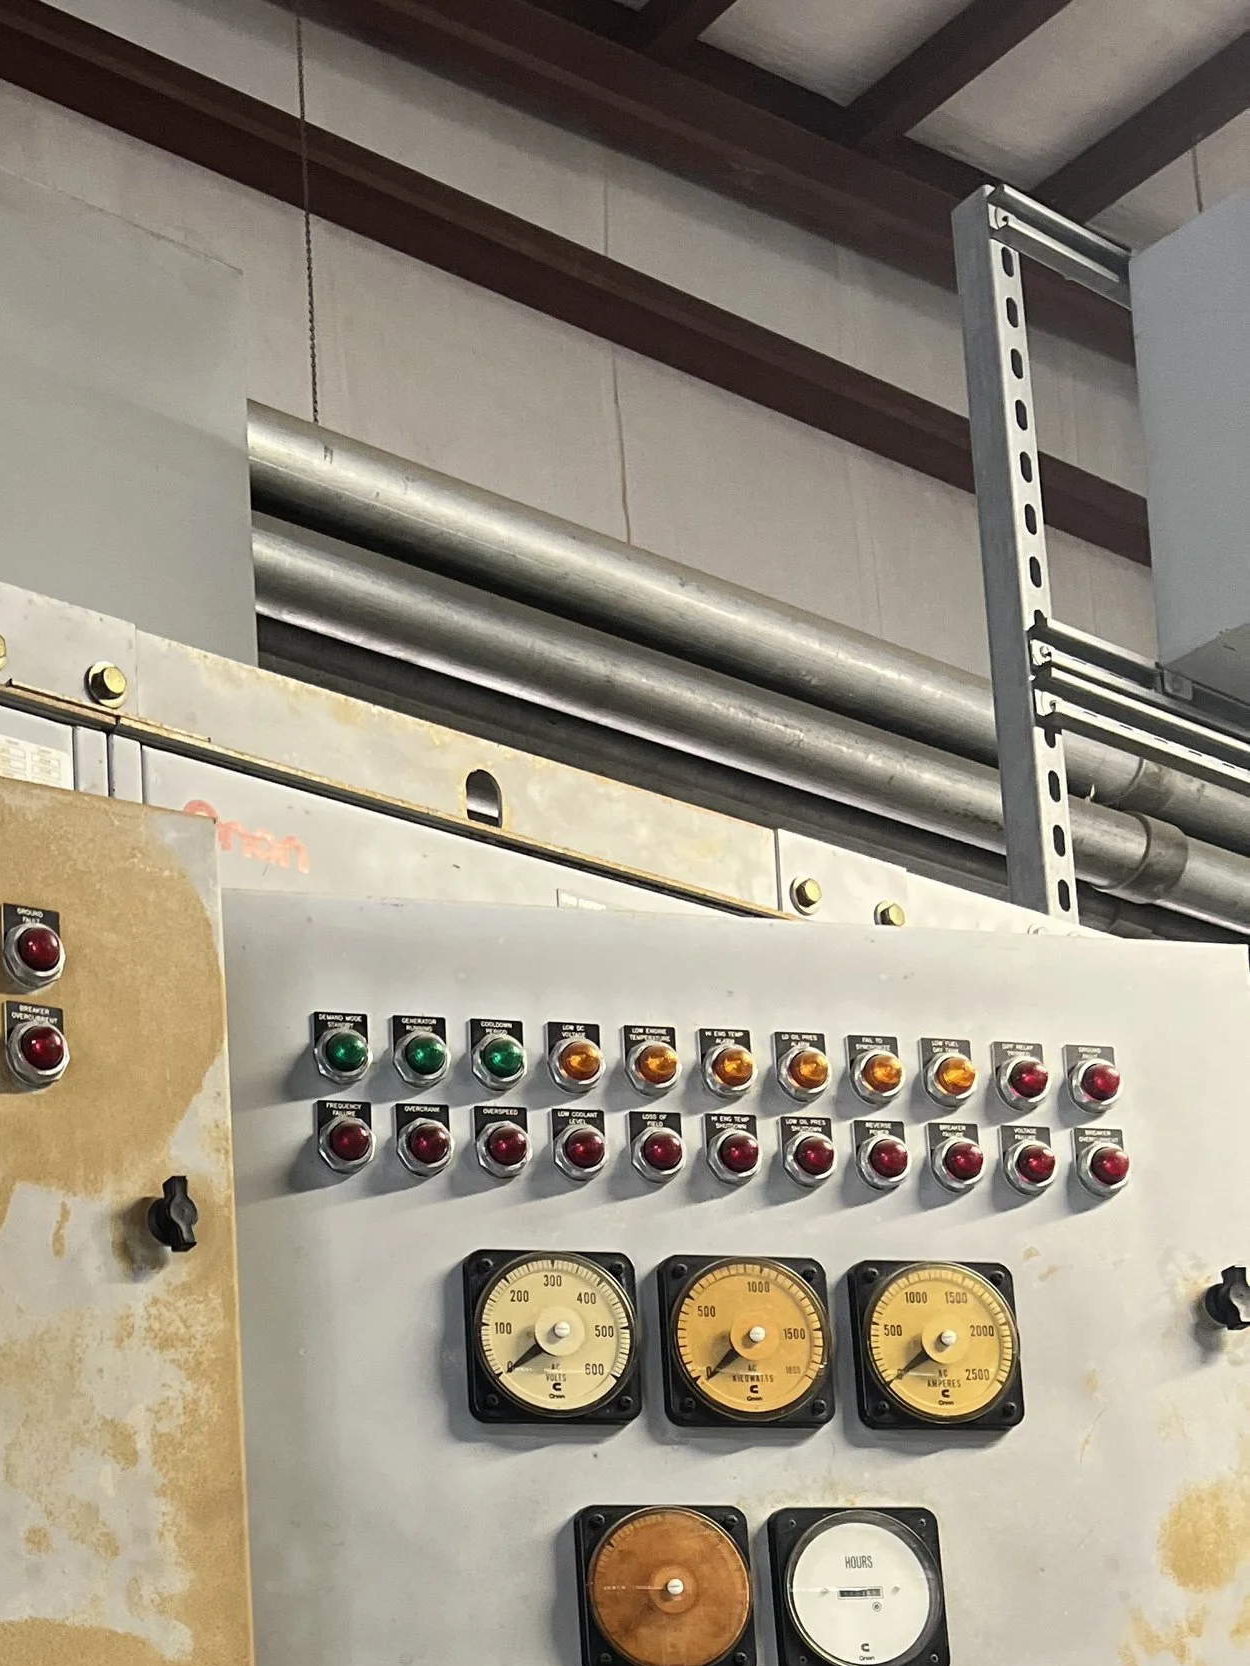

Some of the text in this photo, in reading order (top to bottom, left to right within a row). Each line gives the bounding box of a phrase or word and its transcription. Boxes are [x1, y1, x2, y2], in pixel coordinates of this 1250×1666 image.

[17, 908, 43, 918] GROUND
[19, 1005, 50, 1015] BREAKER
[543, 1274, 562, 1288] 300
[509, 1289, 529, 1302] 200
[576, 1292, 596, 1305] 400
[905, 1292, 927, 1303] 1000
[945, 1292, 968, 1304] 1500
[494, 1322, 512, 1335] 100
[594, 1324, 614, 1338] 500
[884, 1325, 902, 1337] 500
[970, 1325, 994, 1337] 2000
[584, 1363, 604, 1376] 600
[845, 1556, 873, 1568] HOURS
